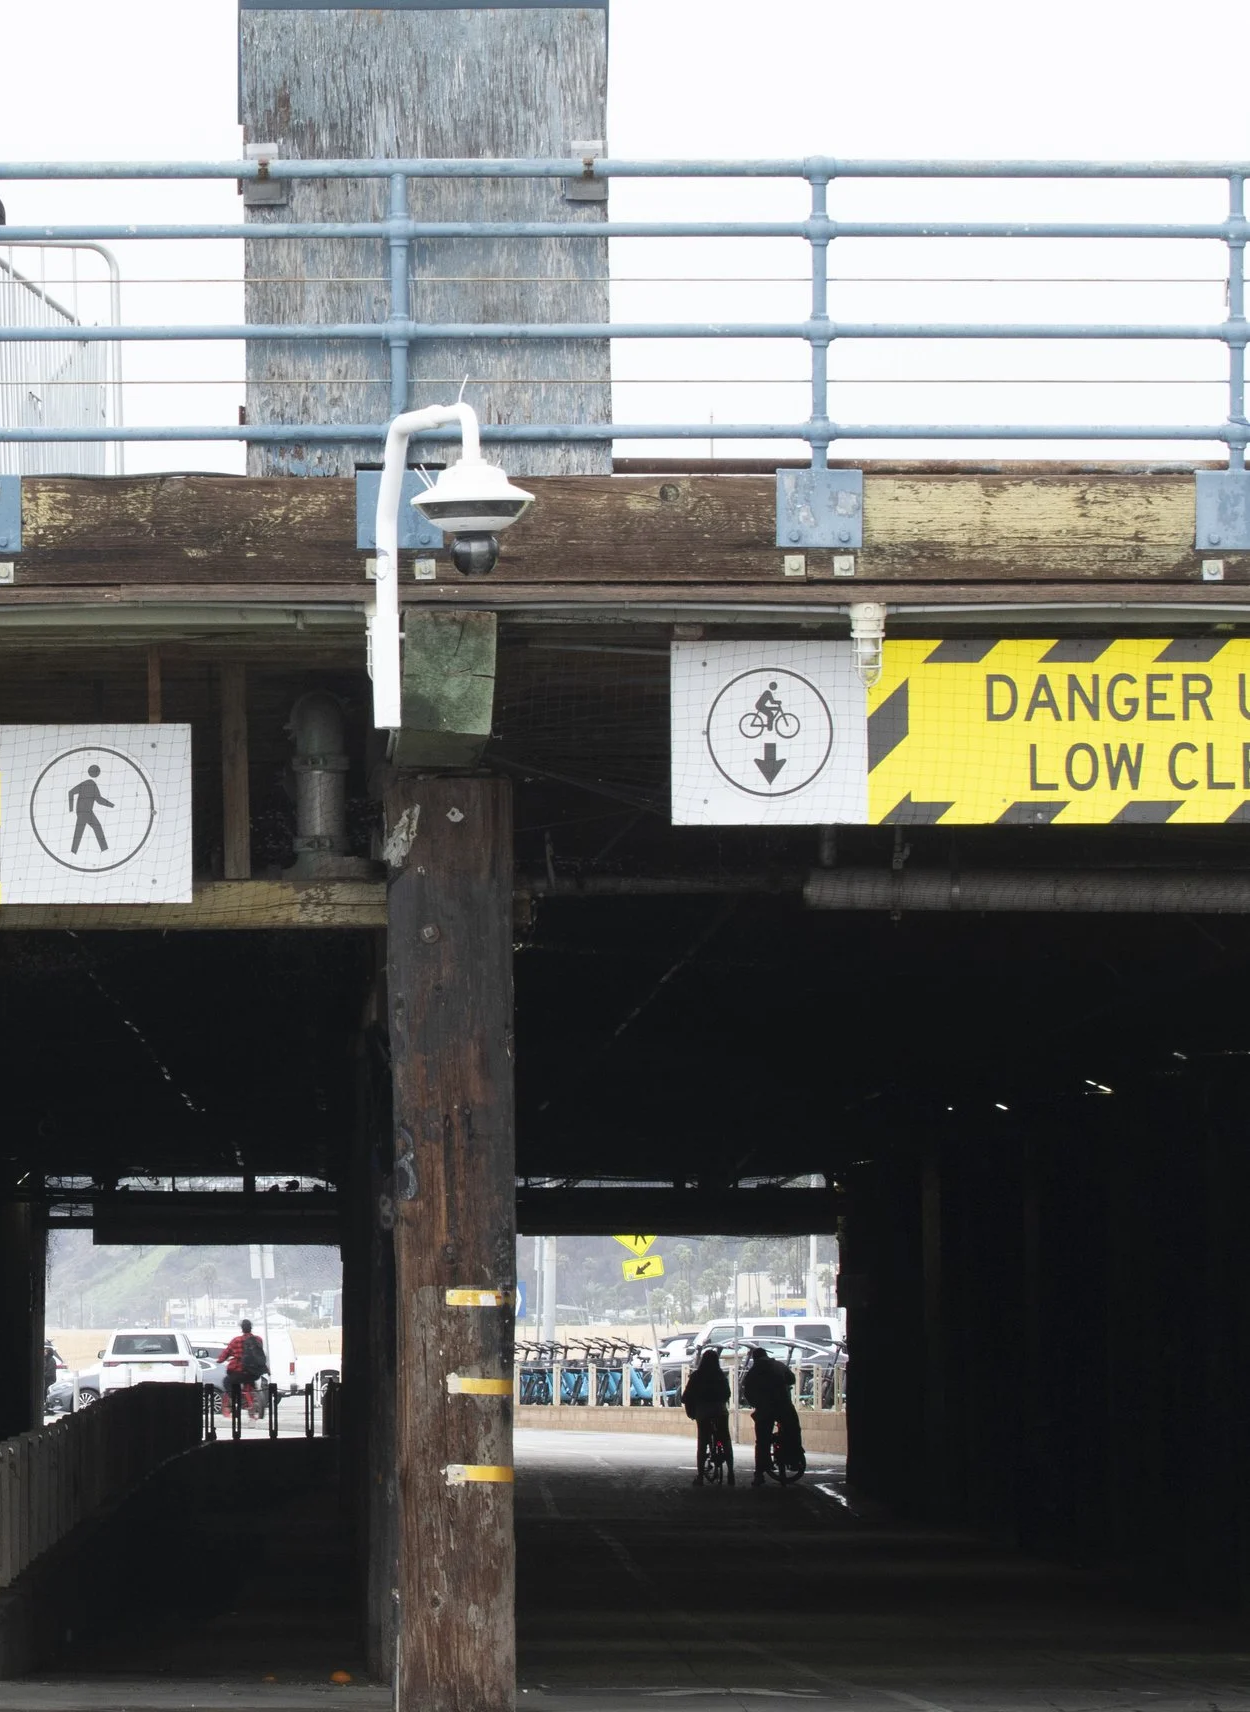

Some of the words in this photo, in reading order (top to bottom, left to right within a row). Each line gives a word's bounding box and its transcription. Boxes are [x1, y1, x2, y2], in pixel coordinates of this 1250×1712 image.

[986, 673, 1214, 721] DANGER
[1030, 743, 1144, 791] LOW
[1169, 742, 1250, 790] CL
